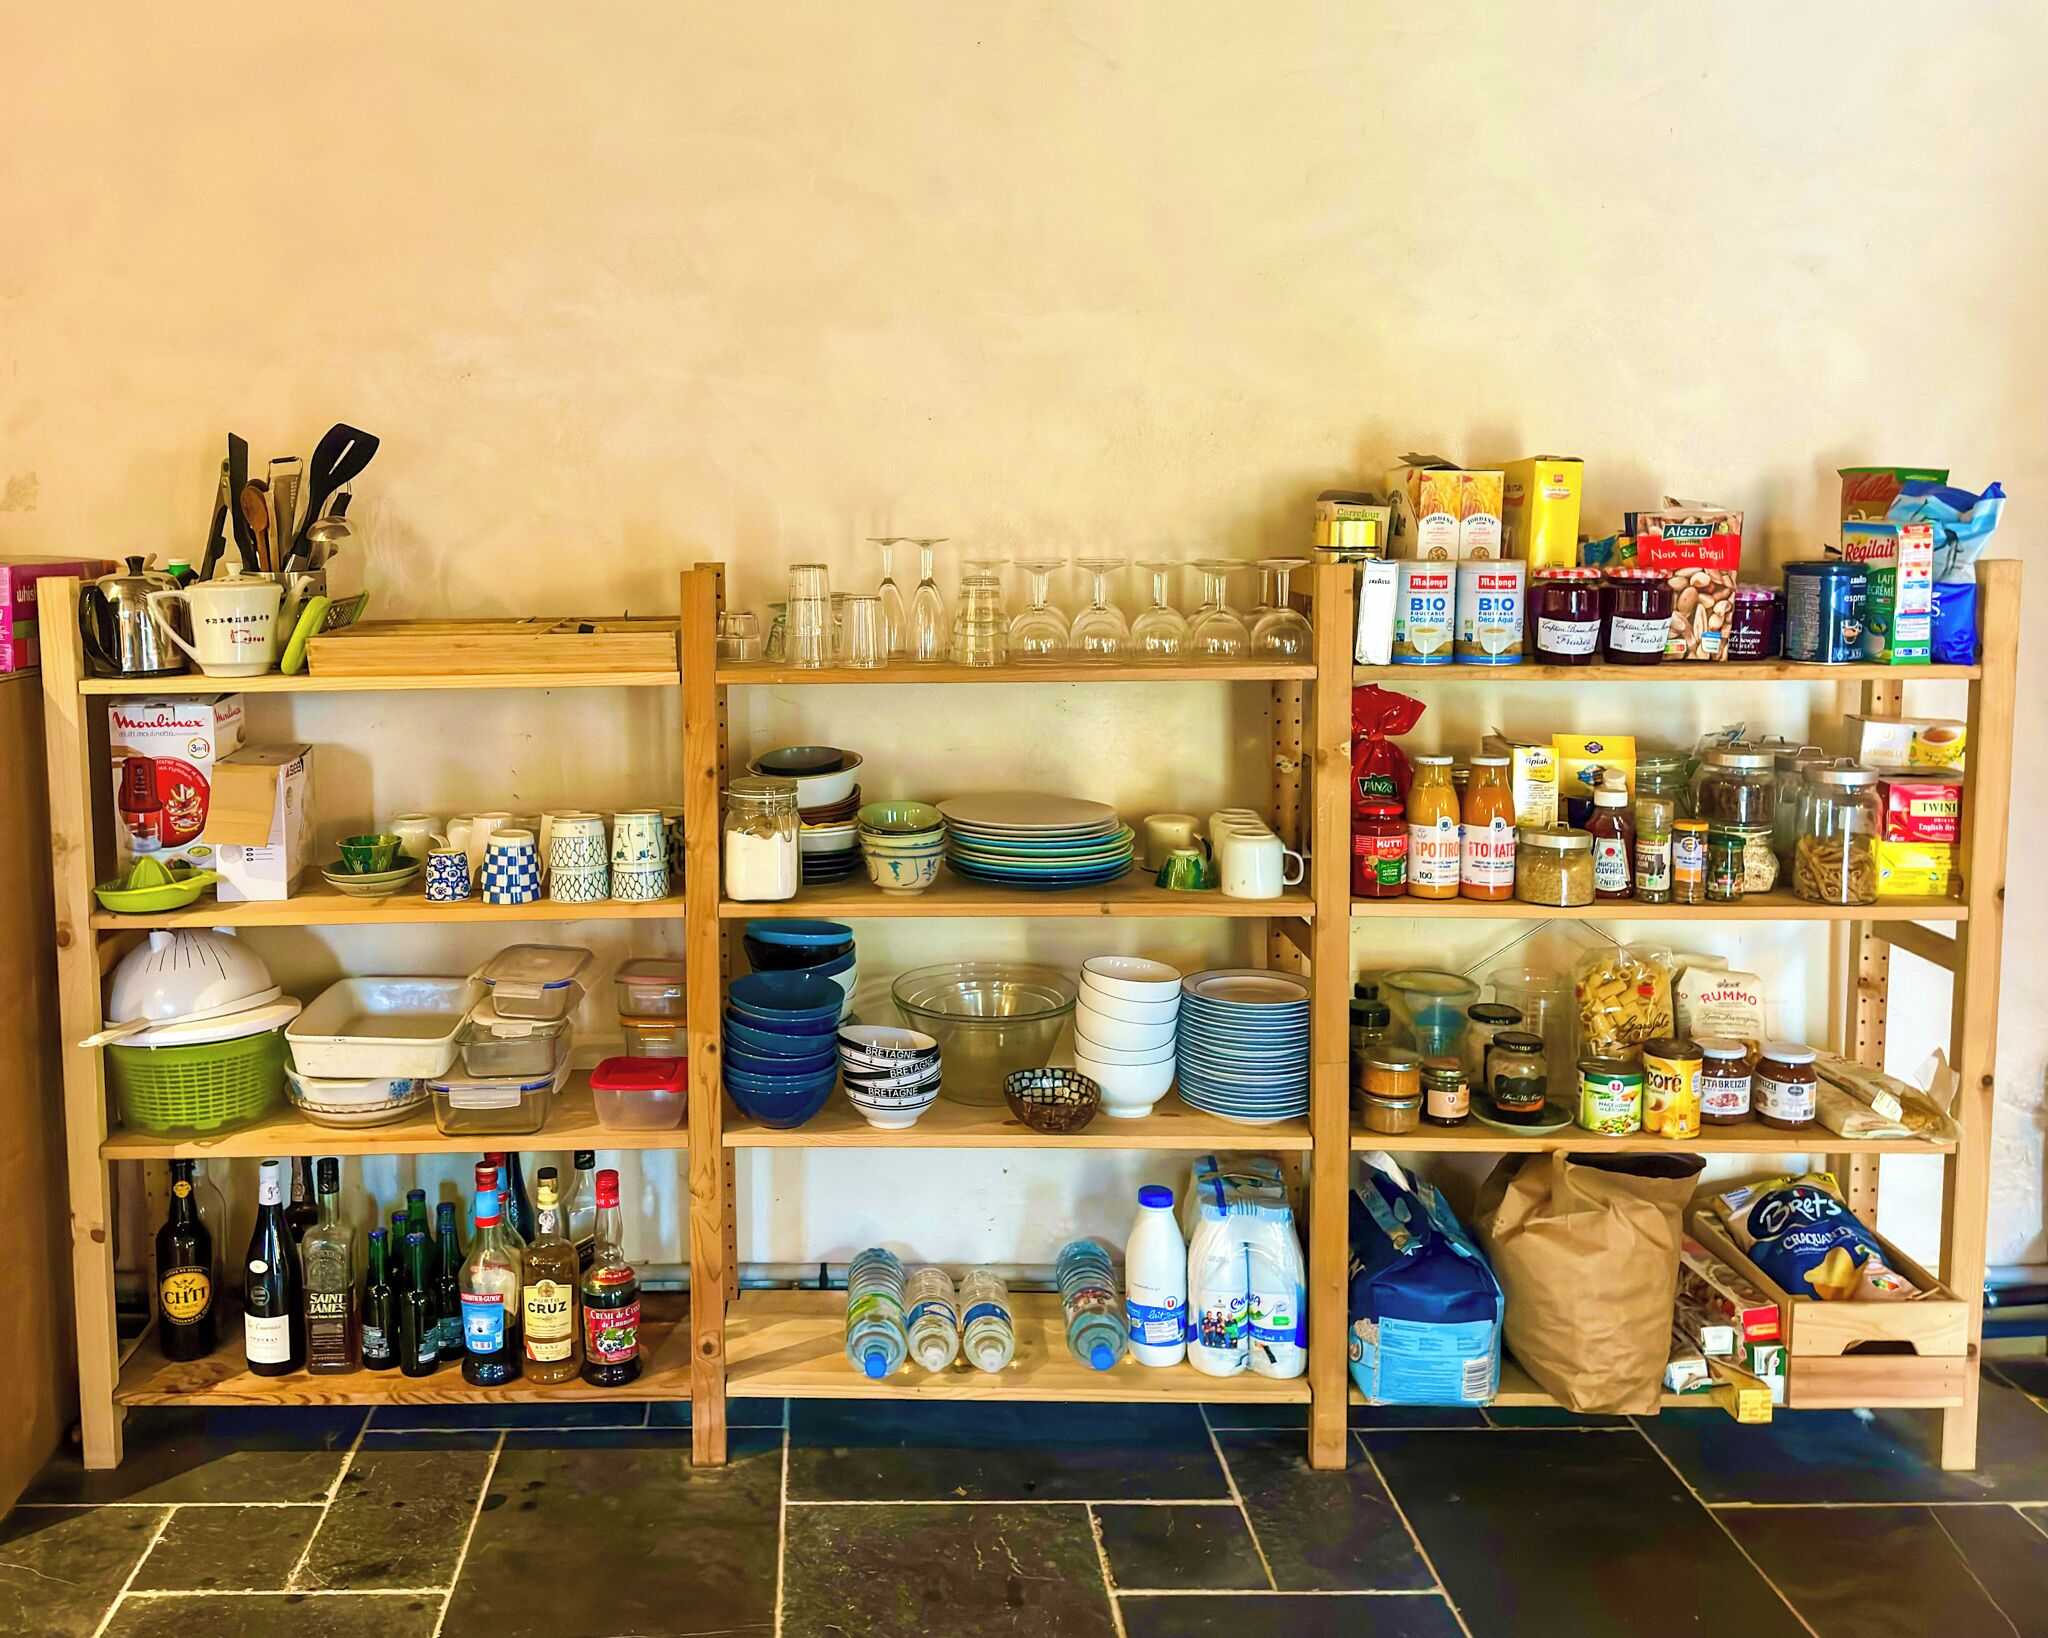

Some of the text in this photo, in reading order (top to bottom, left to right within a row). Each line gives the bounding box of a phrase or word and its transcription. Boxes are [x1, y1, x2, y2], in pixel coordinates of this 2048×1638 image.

[1337, 507, 1380, 518] Carrefour
[1667, 526, 1708, 537] Alesto
[1651, 549, 1677, 561] Noix
[1681, 548, 1695, 558] du
[1845, 538, 1895, 564] Régilait
[1877, 574, 1895, 584] LAIT
[1410, 597, 1446, 611] BIO
[1479, 598, 1515, 611] BIO
[113, 711, 204, 729] Moulinex
[1376, 839, 1402, 848] MUTTI
[1420, 841, 1460, 858] POTIRO
[1475, 842, 1515, 858] TOMATE
[1596, 866, 1624, 875] TOMATO
[1700, 990, 1758, 1006] RUMMO
[865, 1046, 918, 1060] BRETAGNE
[889, 1056, 935, 1078] BRETAGNE
[1646, 1072, 1683, 1093] coré
[868, 1087, 919, 1097] BRETAGNE
[309, 1293, 347, 1304] SAINT
[310, 1303, 347, 1313] JAMES
[528, 1301, 568, 1314] CRUZ
